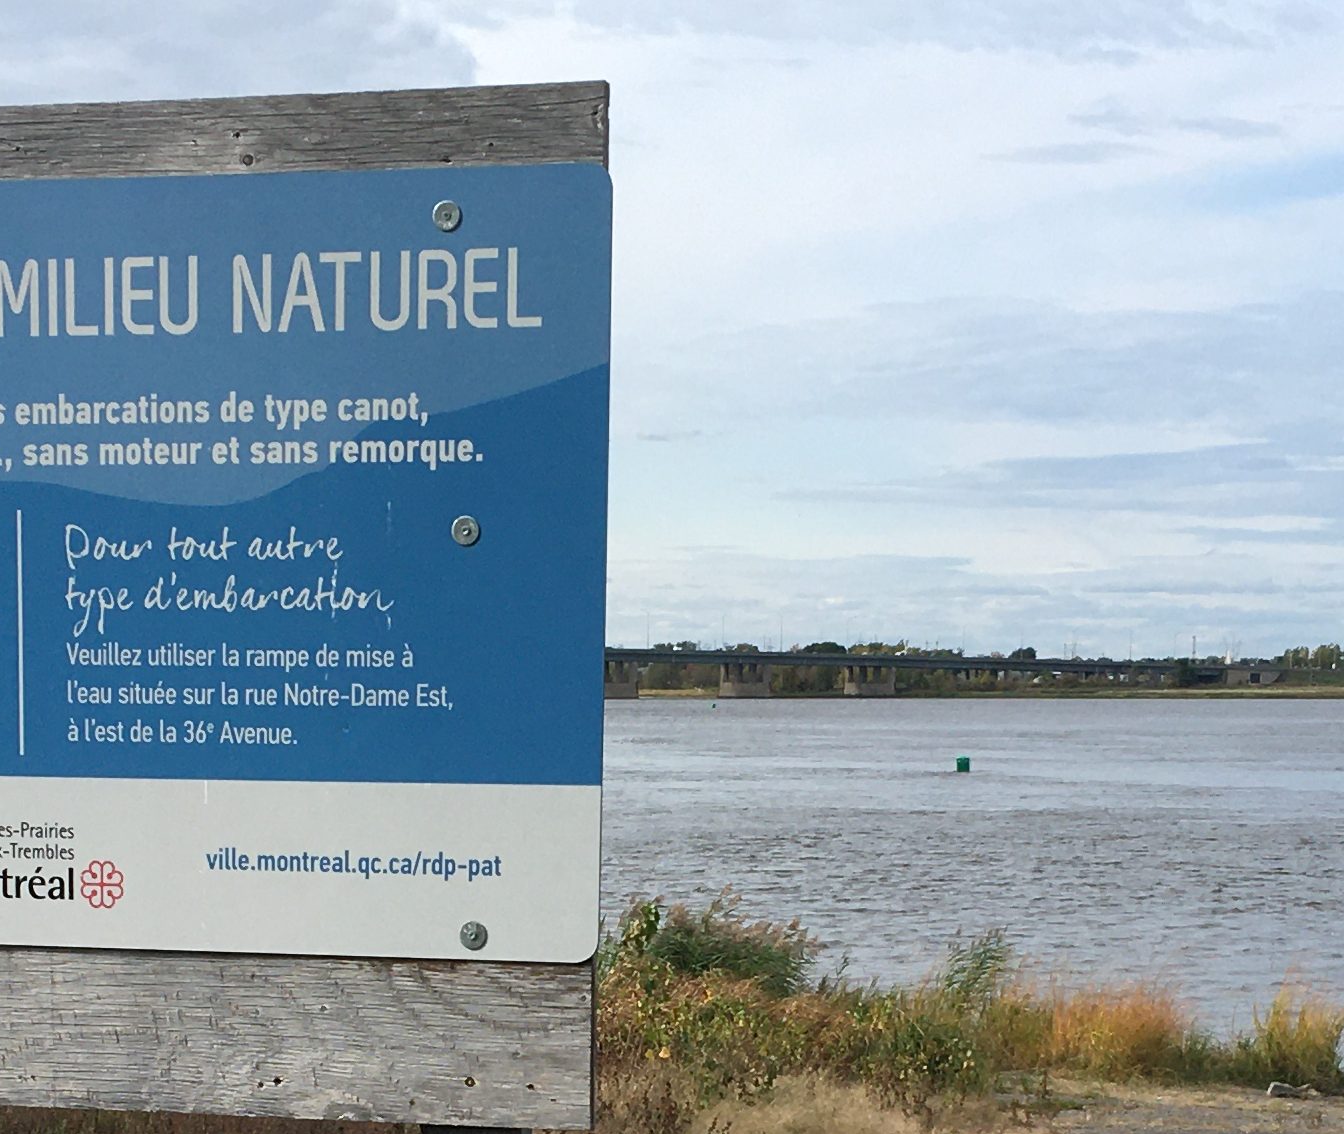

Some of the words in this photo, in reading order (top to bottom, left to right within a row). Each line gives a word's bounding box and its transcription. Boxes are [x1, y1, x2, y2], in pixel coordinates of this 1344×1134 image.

[232, 247, 543, 334] NATUREL
[14, 393, 210, 425] embarcations
[220, 391, 255, 423] de
[264, 394, 328, 431] type
[337, 392, 428, 427] canot,
[22, 442, 89, 467] sans
[99, 437, 203, 466] moteur
[211, 436, 240, 465] et
[250, 440, 319, 465] sans
[329, 439, 483, 471] remorque.
[65, 523, 153, 570] Pour
[167, 526, 238, 561] tout
[247, 526, 344, 562] autre
[64, 576, 134, 638] type
[143, 571, 394, 613] d'embarcation
[66, 641, 142, 667] Veuillez
[147, 642, 216, 667] utiliser
[222, 642, 240, 667] la
[246, 648, 310, 673] rampe
[315, 643, 340, 668] de
[346, 643, 395, 668] mise
[401, 642, 414, 668] à
[67, 679, 112, 705] l'eau
[118, 680, 177, 705] située
[182, 686, 216, 706] sur
[221, 681, 239, 706] la
[245, 687, 278, 706] rue
[284, 682, 410, 707] Notre-Dame
[416, 683, 454, 711] Est,
[67, 717, 79, 742] à
[84, 718, 125, 743] l'est
[130, 718, 154, 743] de
[159, 719, 177, 743] la
[219, 720, 298, 746] Avenue.
[206, 847, 502, 882] ville.montreal.qc.ca/rdp-pat
